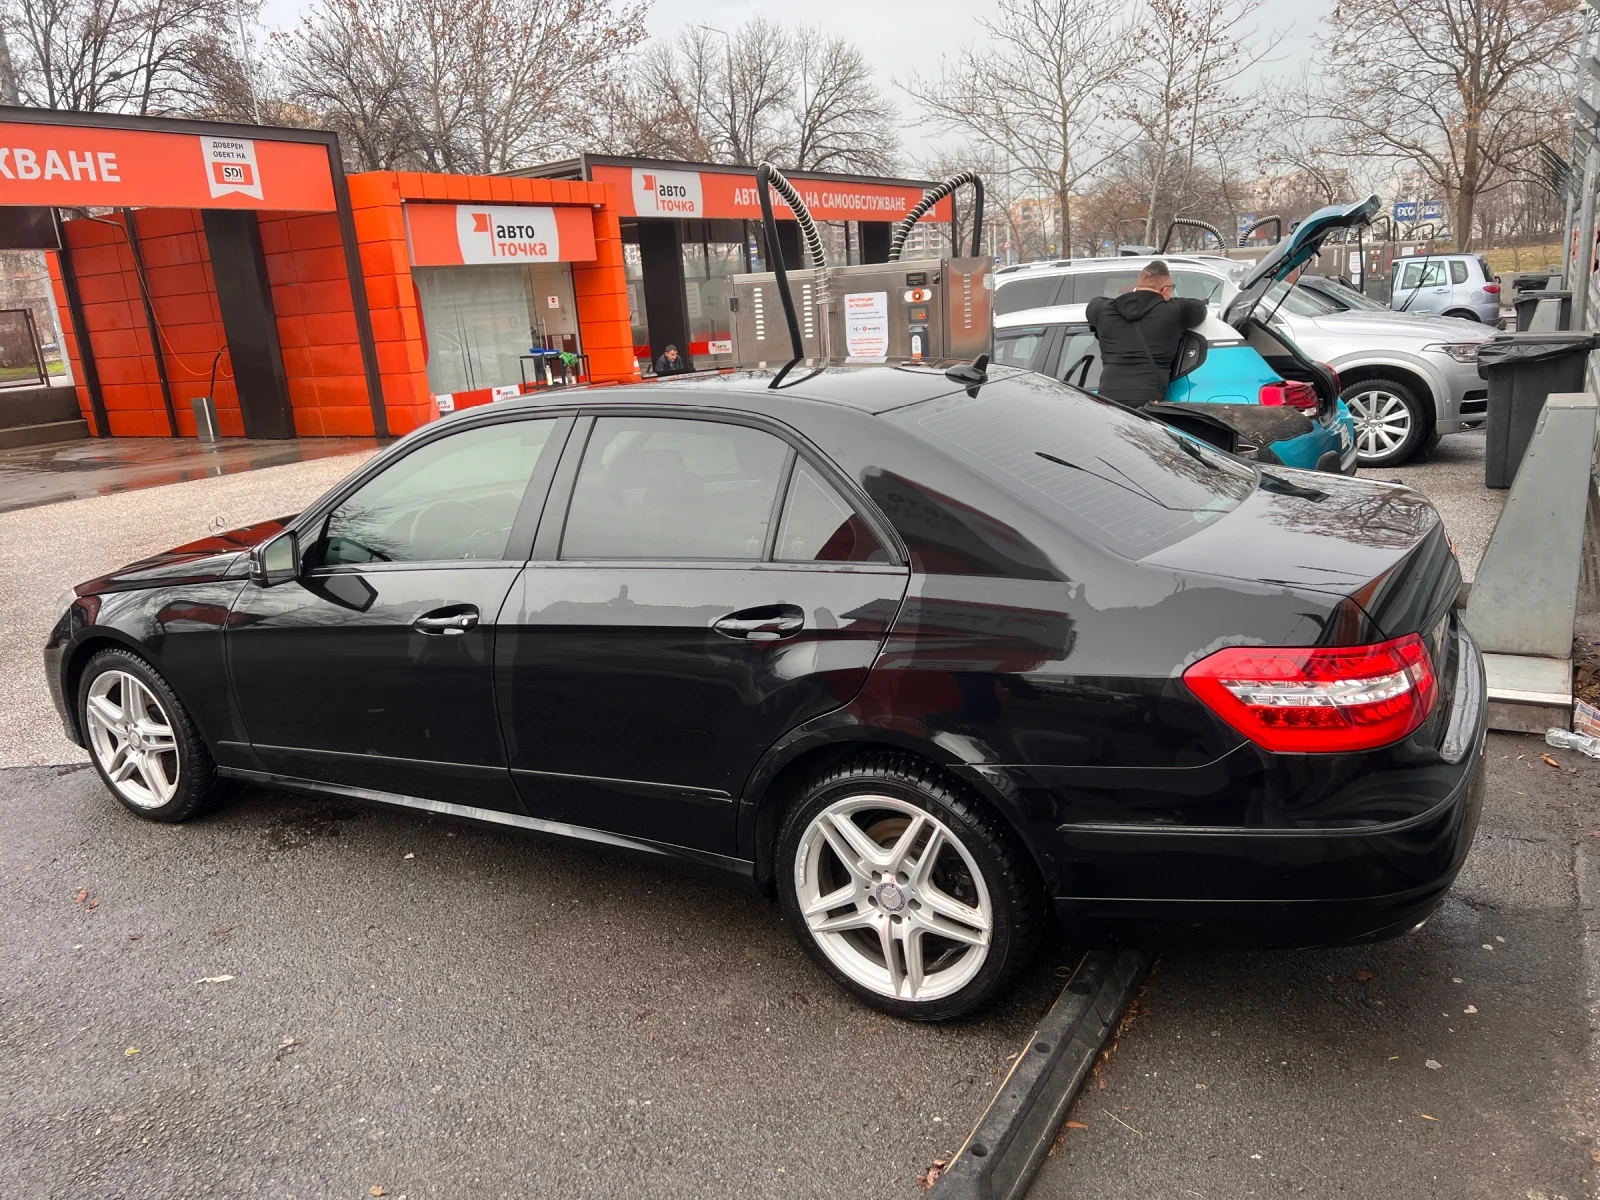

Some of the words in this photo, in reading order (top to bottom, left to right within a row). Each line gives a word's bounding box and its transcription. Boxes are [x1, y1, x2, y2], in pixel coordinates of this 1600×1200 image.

[212, 141, 244, 150] ДОВЕРЕН
[213, 150, 235, 159] ОБЕКТ
[224, 167, 243, 178] SDI
[659, 184, 686, 198] авто
[660, 199, 695, 212] точка
[805, 191, 820, 207] НА
[821, 192, 906, 211] САМООБСЛУЖВАНЕ
[496, 224, 535, 239] авто
[498, 242, 548, 257] точка
